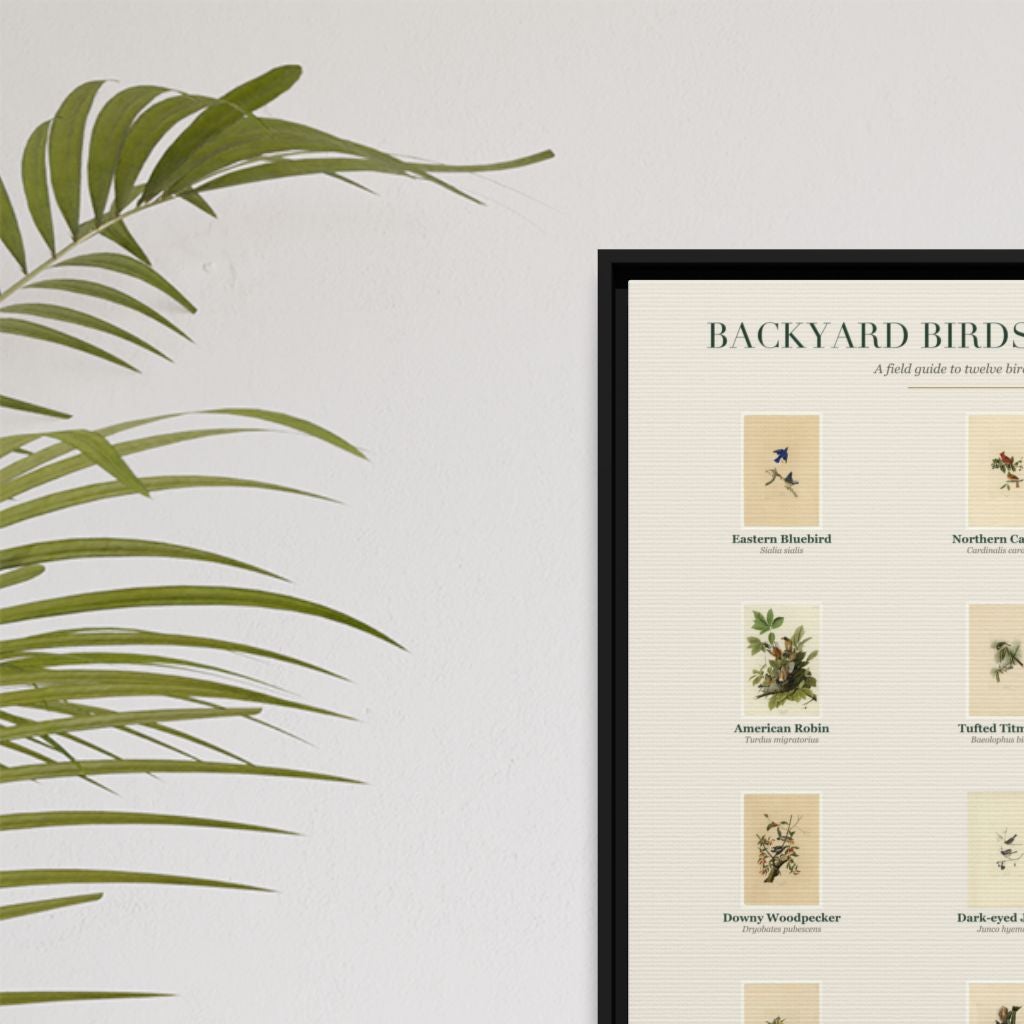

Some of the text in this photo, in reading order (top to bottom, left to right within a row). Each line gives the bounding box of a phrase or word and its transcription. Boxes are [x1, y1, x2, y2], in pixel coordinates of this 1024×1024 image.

[707, 321, 909, 349] BACKYARD
[873, 363, 883, 374] A
[884, 363, 912, 377] field
[914, 363, 947, 377] guide
[950, 364, 962, 374] to
[964, 363, 1002, 374] twelve
[731, 533, 832, 544] Eastern Bluebird
[951, 533, 1007, 544] Northern
[734, 722, 830, 734] American Robin
[957, 722, 997, 734] Tufted
[723, 912, 841, 925] Downy Woodpecker
[957, 912, 1018, 925] Dark-eyed
